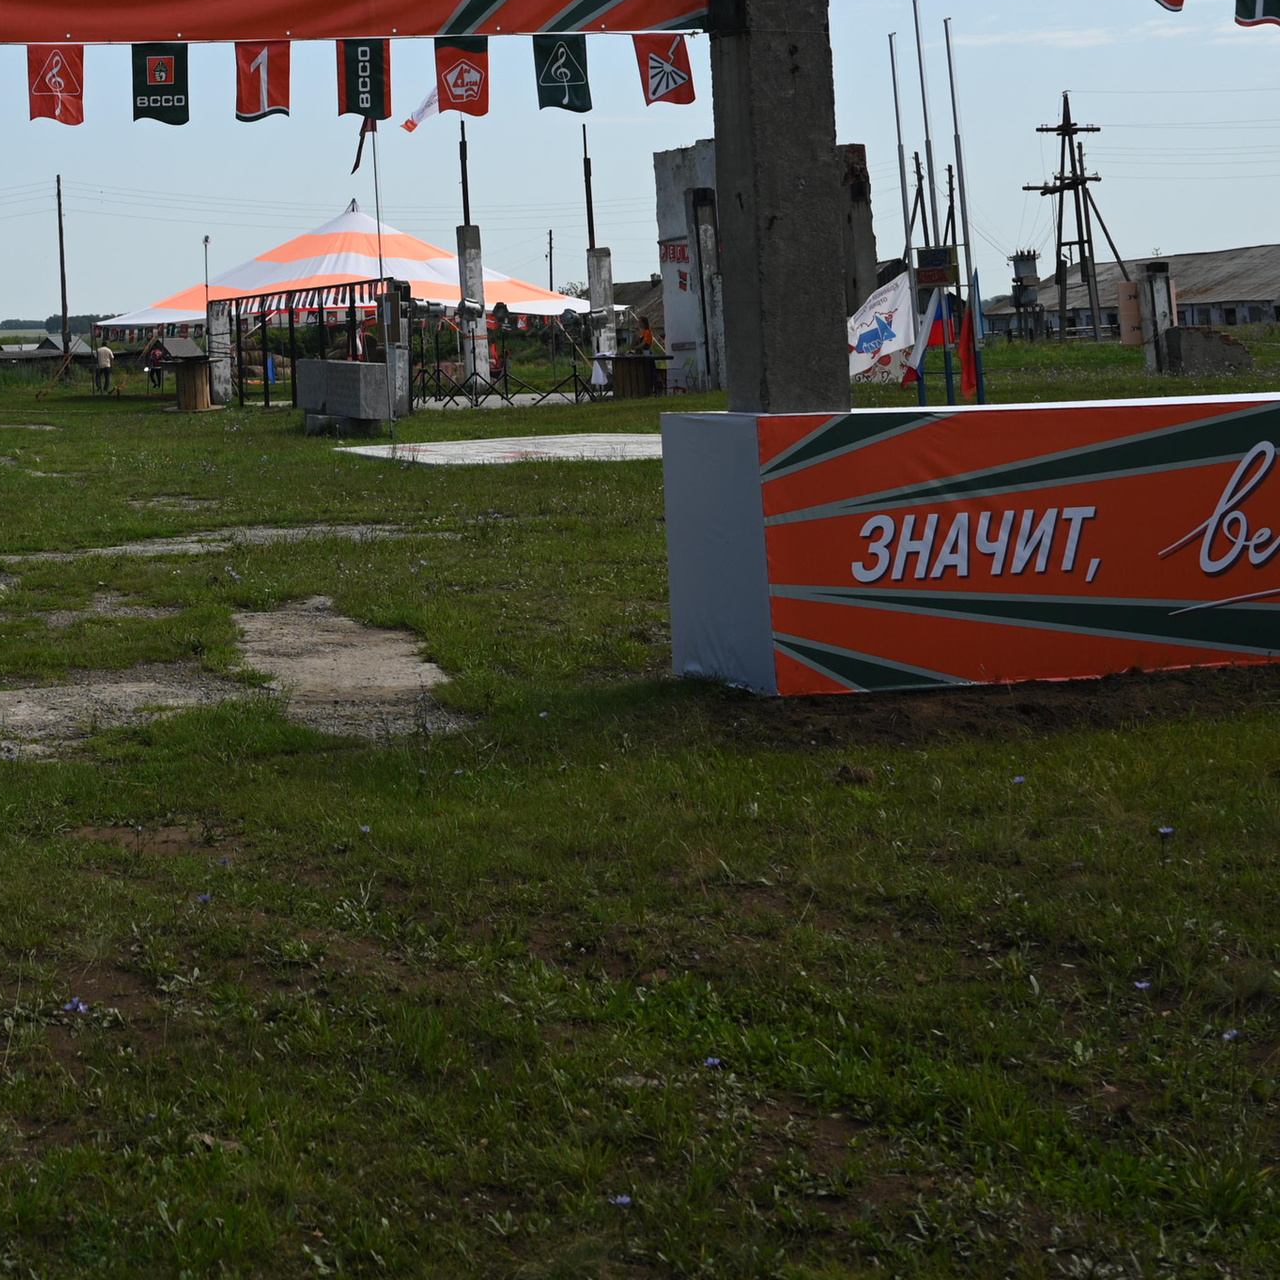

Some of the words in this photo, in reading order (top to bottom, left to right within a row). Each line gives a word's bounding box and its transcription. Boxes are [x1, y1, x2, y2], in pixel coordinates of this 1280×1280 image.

[136, 94, 186, 108] ВССО
[250, 45, 269, 112] 1
[357, 46, 371, 109] ВССО
[851, 506, 1101, 583] ЗНАЧИТ,
